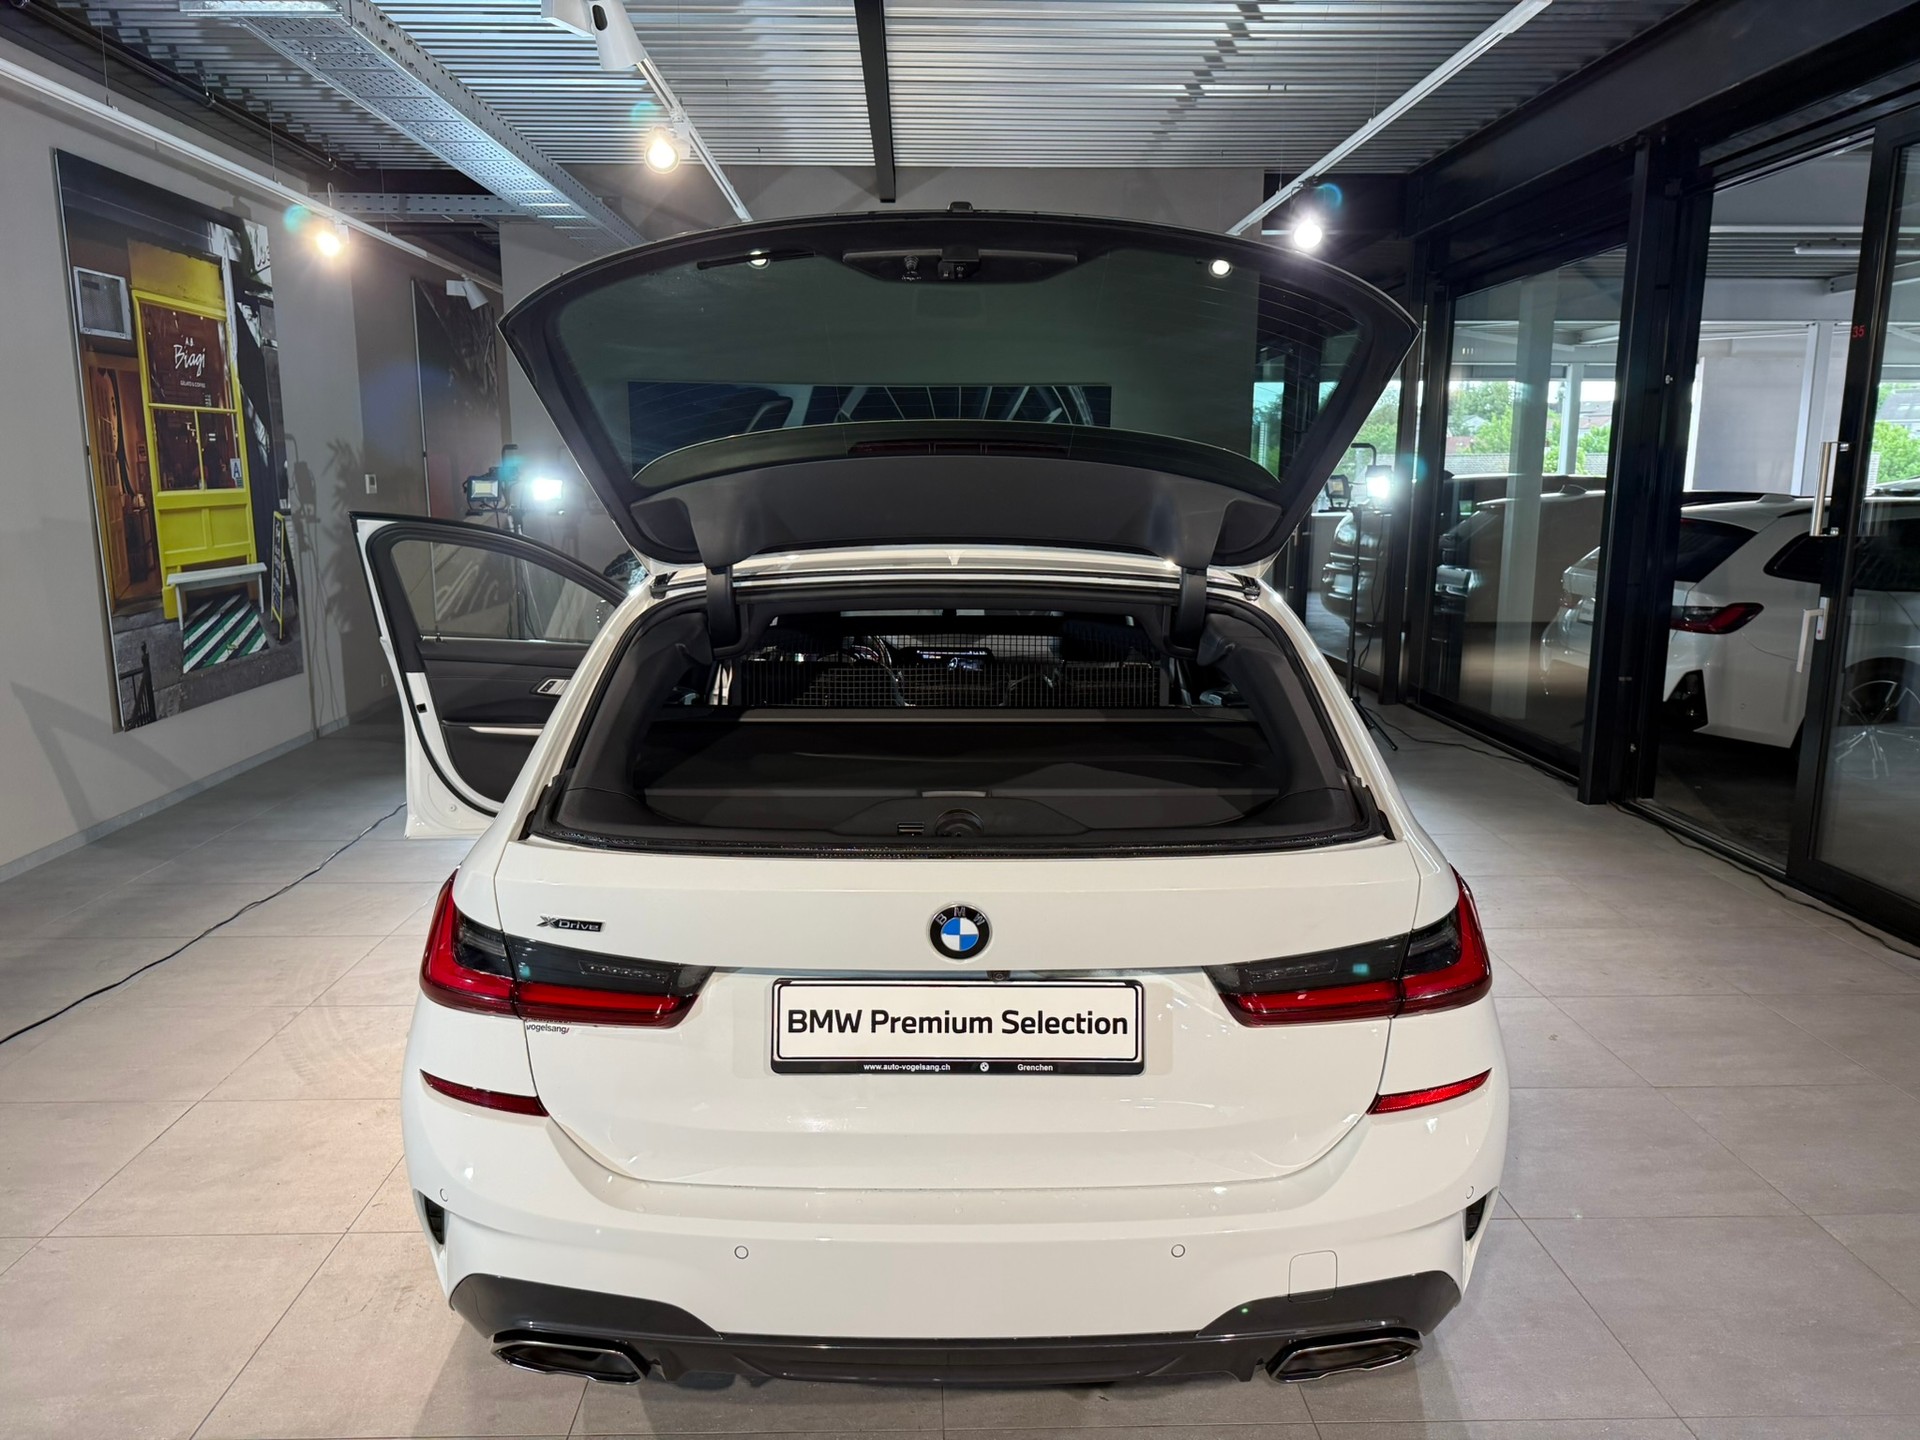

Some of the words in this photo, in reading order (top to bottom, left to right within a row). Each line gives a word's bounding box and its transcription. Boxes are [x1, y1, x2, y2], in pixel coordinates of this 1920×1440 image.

[1852, 325, 1865, 338] 35
[173, 344, 206, 377] Biagi
[233, 461, 241, 478] A
[935, 906, 986, 926] BMW
[787, 1009, 863, 1034] BMW
[870, 1009, 993, 1034] Premium
[1001, 1009, 1128, 1035] Selection
[863, 1062, 951, 1073] www.auto-vogelsang.ch
[1017, 1063, 1054, 1072] Grenchen
